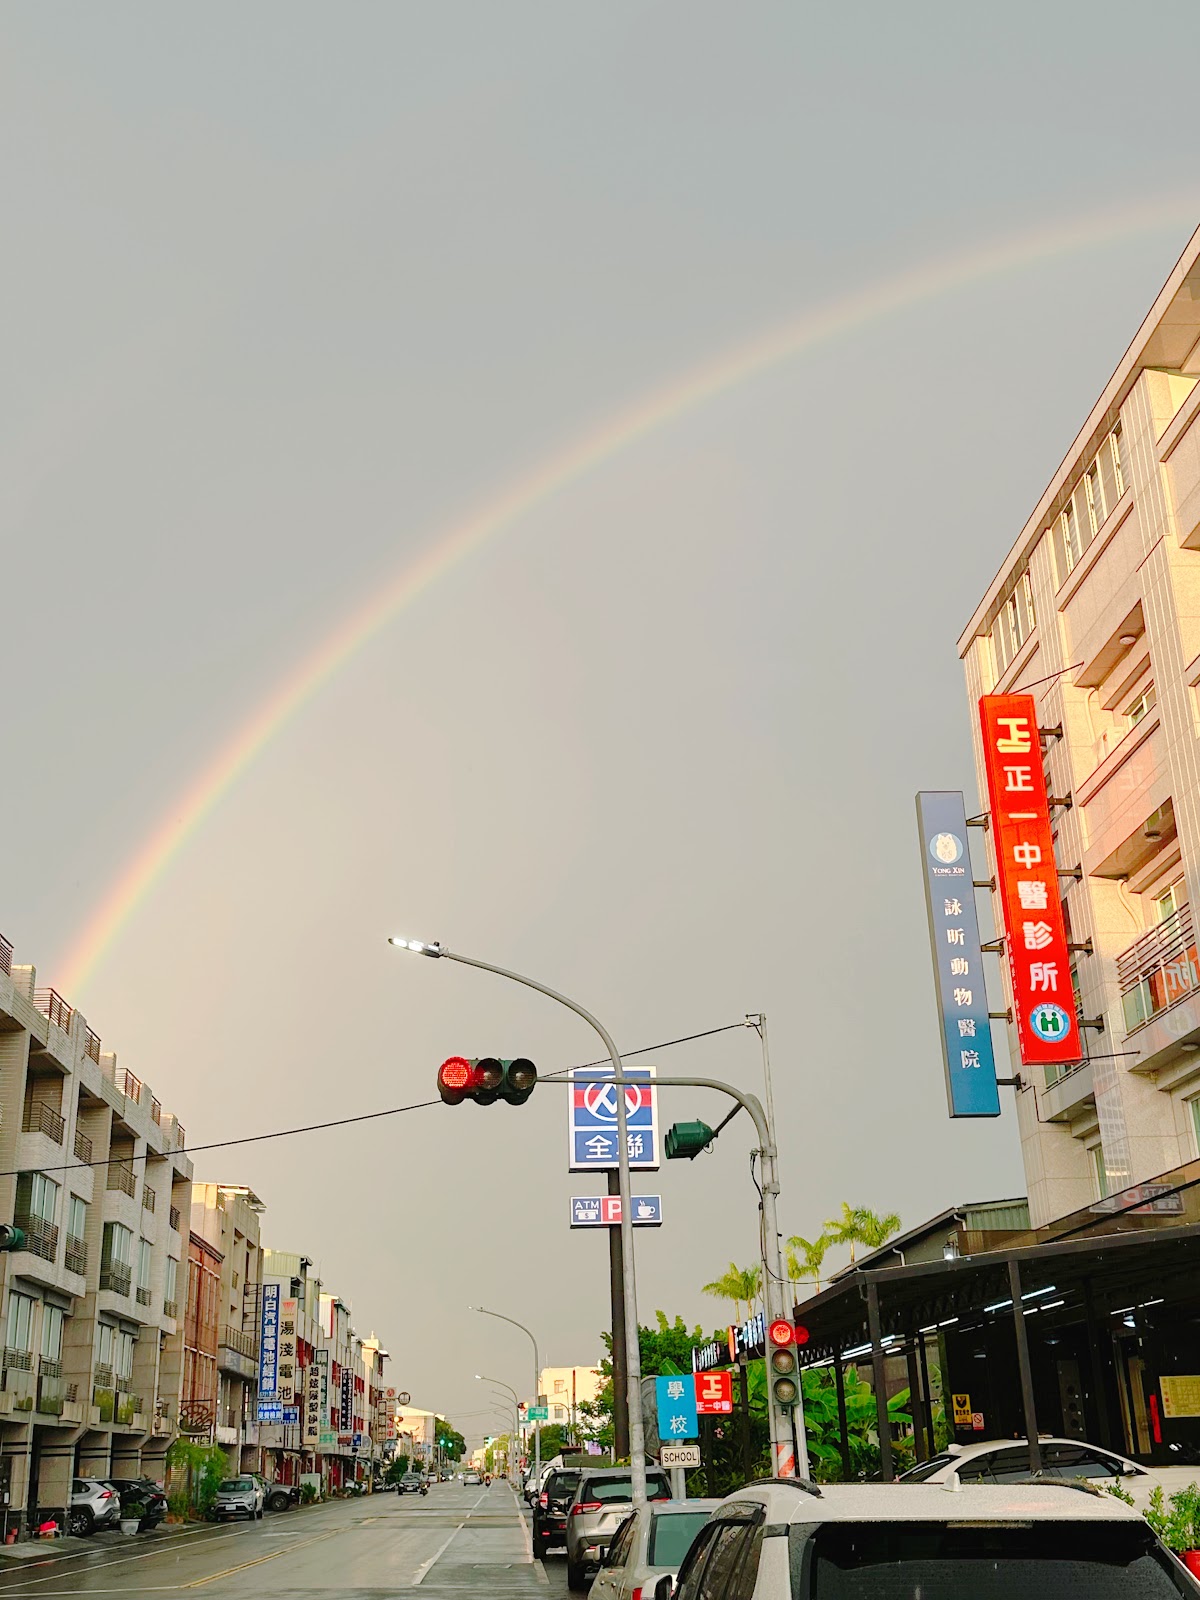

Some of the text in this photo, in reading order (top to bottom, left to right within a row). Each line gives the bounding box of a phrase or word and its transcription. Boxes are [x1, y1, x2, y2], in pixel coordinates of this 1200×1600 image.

[1003, 765, 1059, 992] 正一中醫診所
[943, 898, 981, 1069] 詠昕動物醫院
[574, 1200, 600, 1210] ATM
[607, 1200, 622, 1220] P
[261, 1285, 278, 1391] 明白汽車電池經銷
[278, 1320, 295, 1401] 湯淺電池
[667, 1381, 688, 1434] 學校
[696, 1401, 731, 1411] 正一中醫
[663, 1450, 697, 1463] SCHOOL
